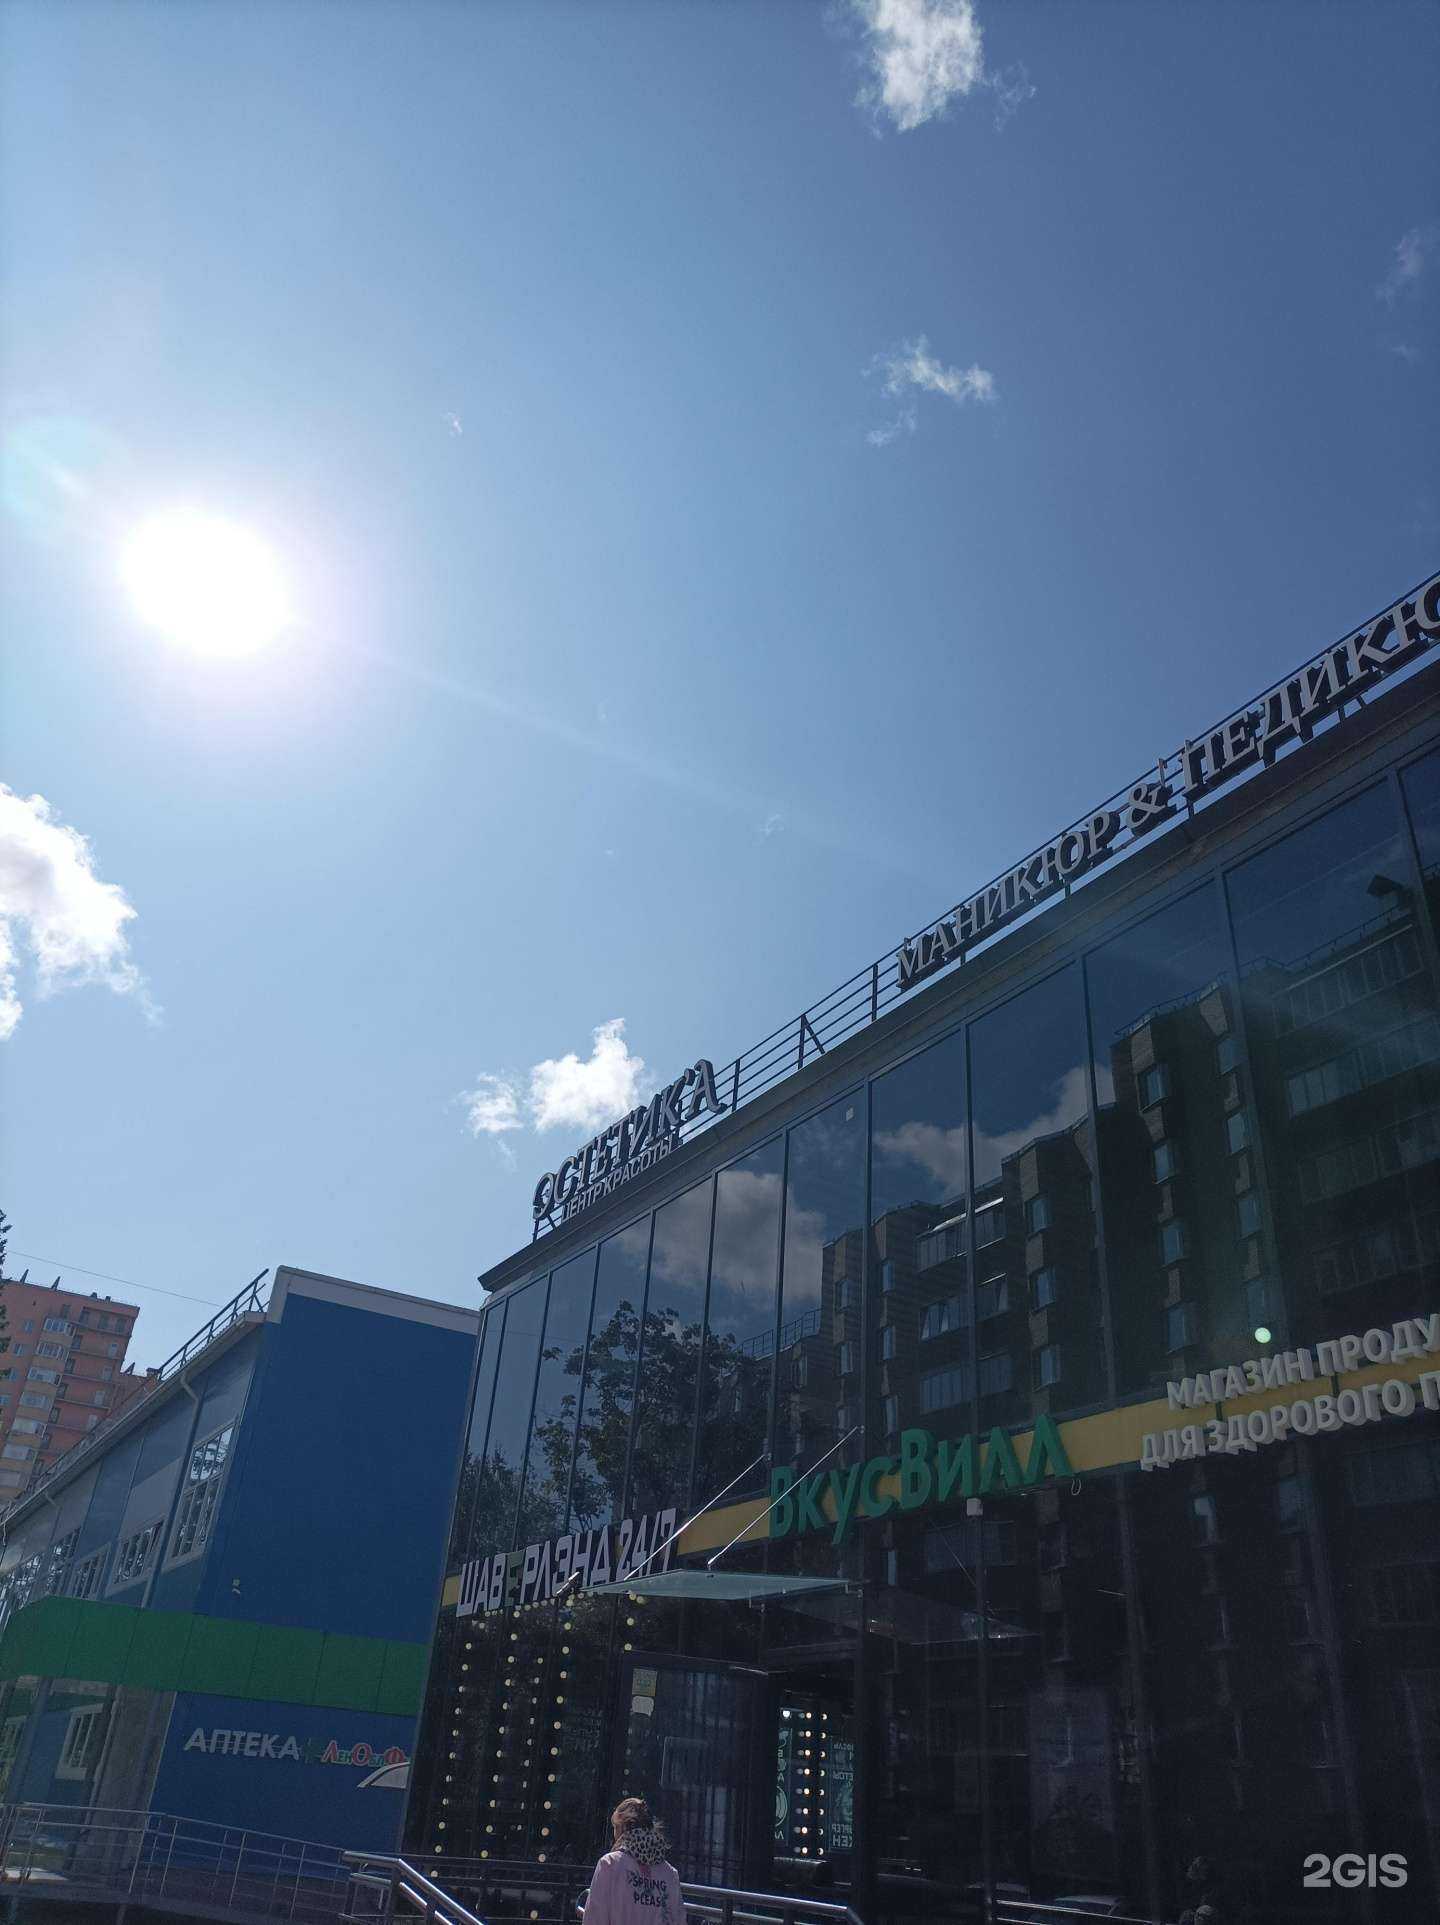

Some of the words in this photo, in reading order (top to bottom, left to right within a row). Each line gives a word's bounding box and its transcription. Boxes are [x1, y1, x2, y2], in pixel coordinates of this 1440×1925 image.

[895, 810, 1120, 989] МАНИКЮР
[1126, 780, 1177, 838] &
[532, 1058, 727, 1221] ЭСТЕТИКА
[560, 1185, 603, 1222] ЦЕНТР
[602, 1136, 677, 1197] КРАСОТЫ
[1166, 1347, 1315, 1411] МАГАЗИН
[1140, 1424, 1206, 1471] ДЛЯ
[1205, 1378, 1416, 1456] ЗДОРОВОГО
[615, 1507, 677, 1581] 24/7
[184, 1727, 300, 1761] АПТЕКА
